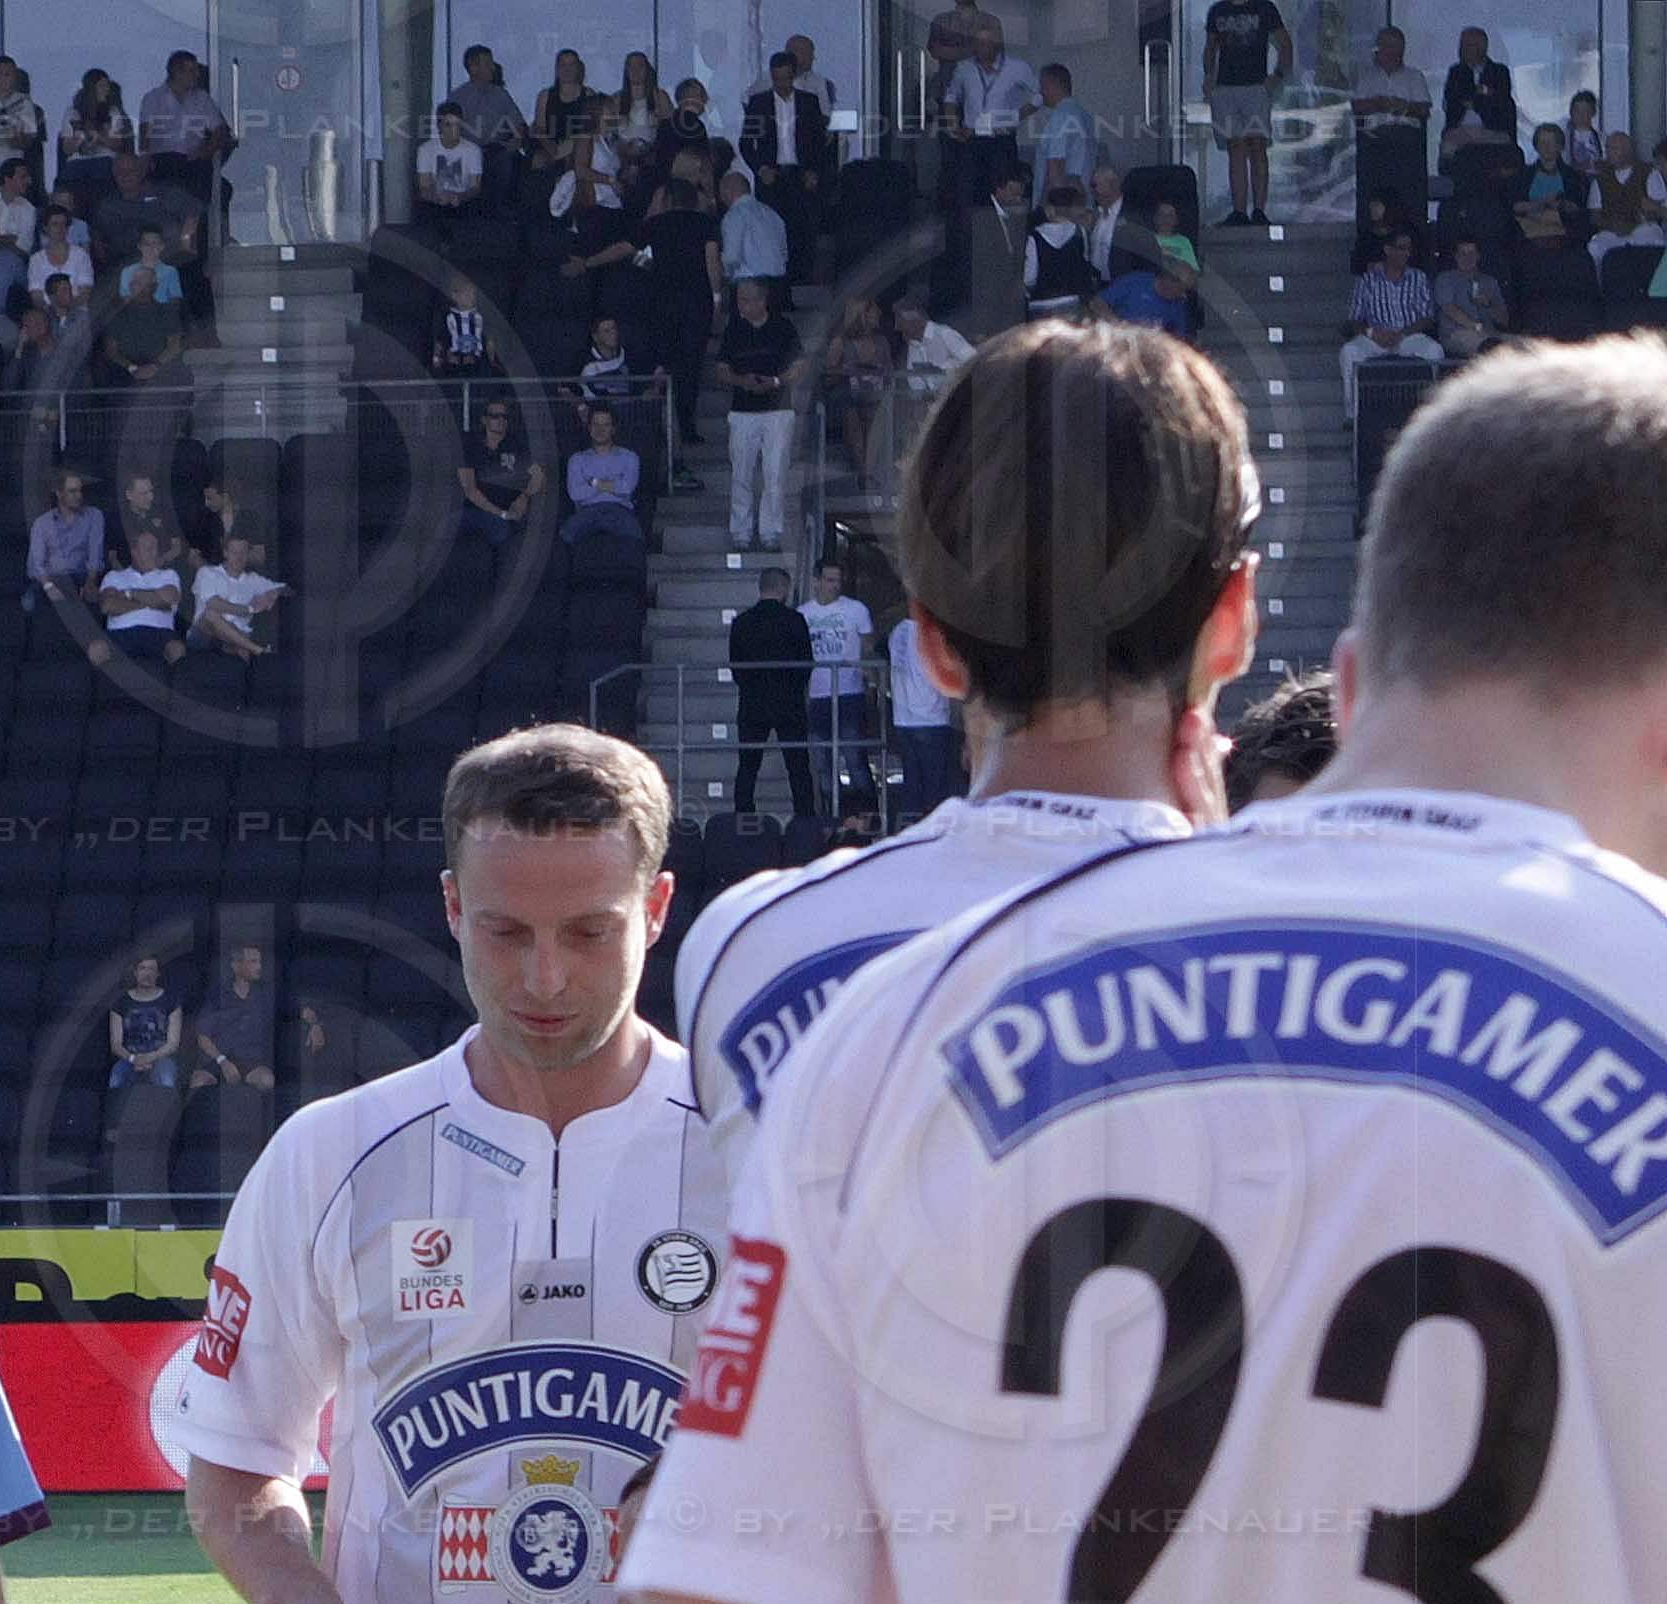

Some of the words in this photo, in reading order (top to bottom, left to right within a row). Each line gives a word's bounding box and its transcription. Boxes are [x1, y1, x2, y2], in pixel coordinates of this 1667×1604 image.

[399, 1274, 464, 1290] BUNDES
[541, 1284, 586, 1299] JAKO
[399, 1289, 466, 1312] LIGA
[387, 1368, 680, 1472] PUNTIGAME
